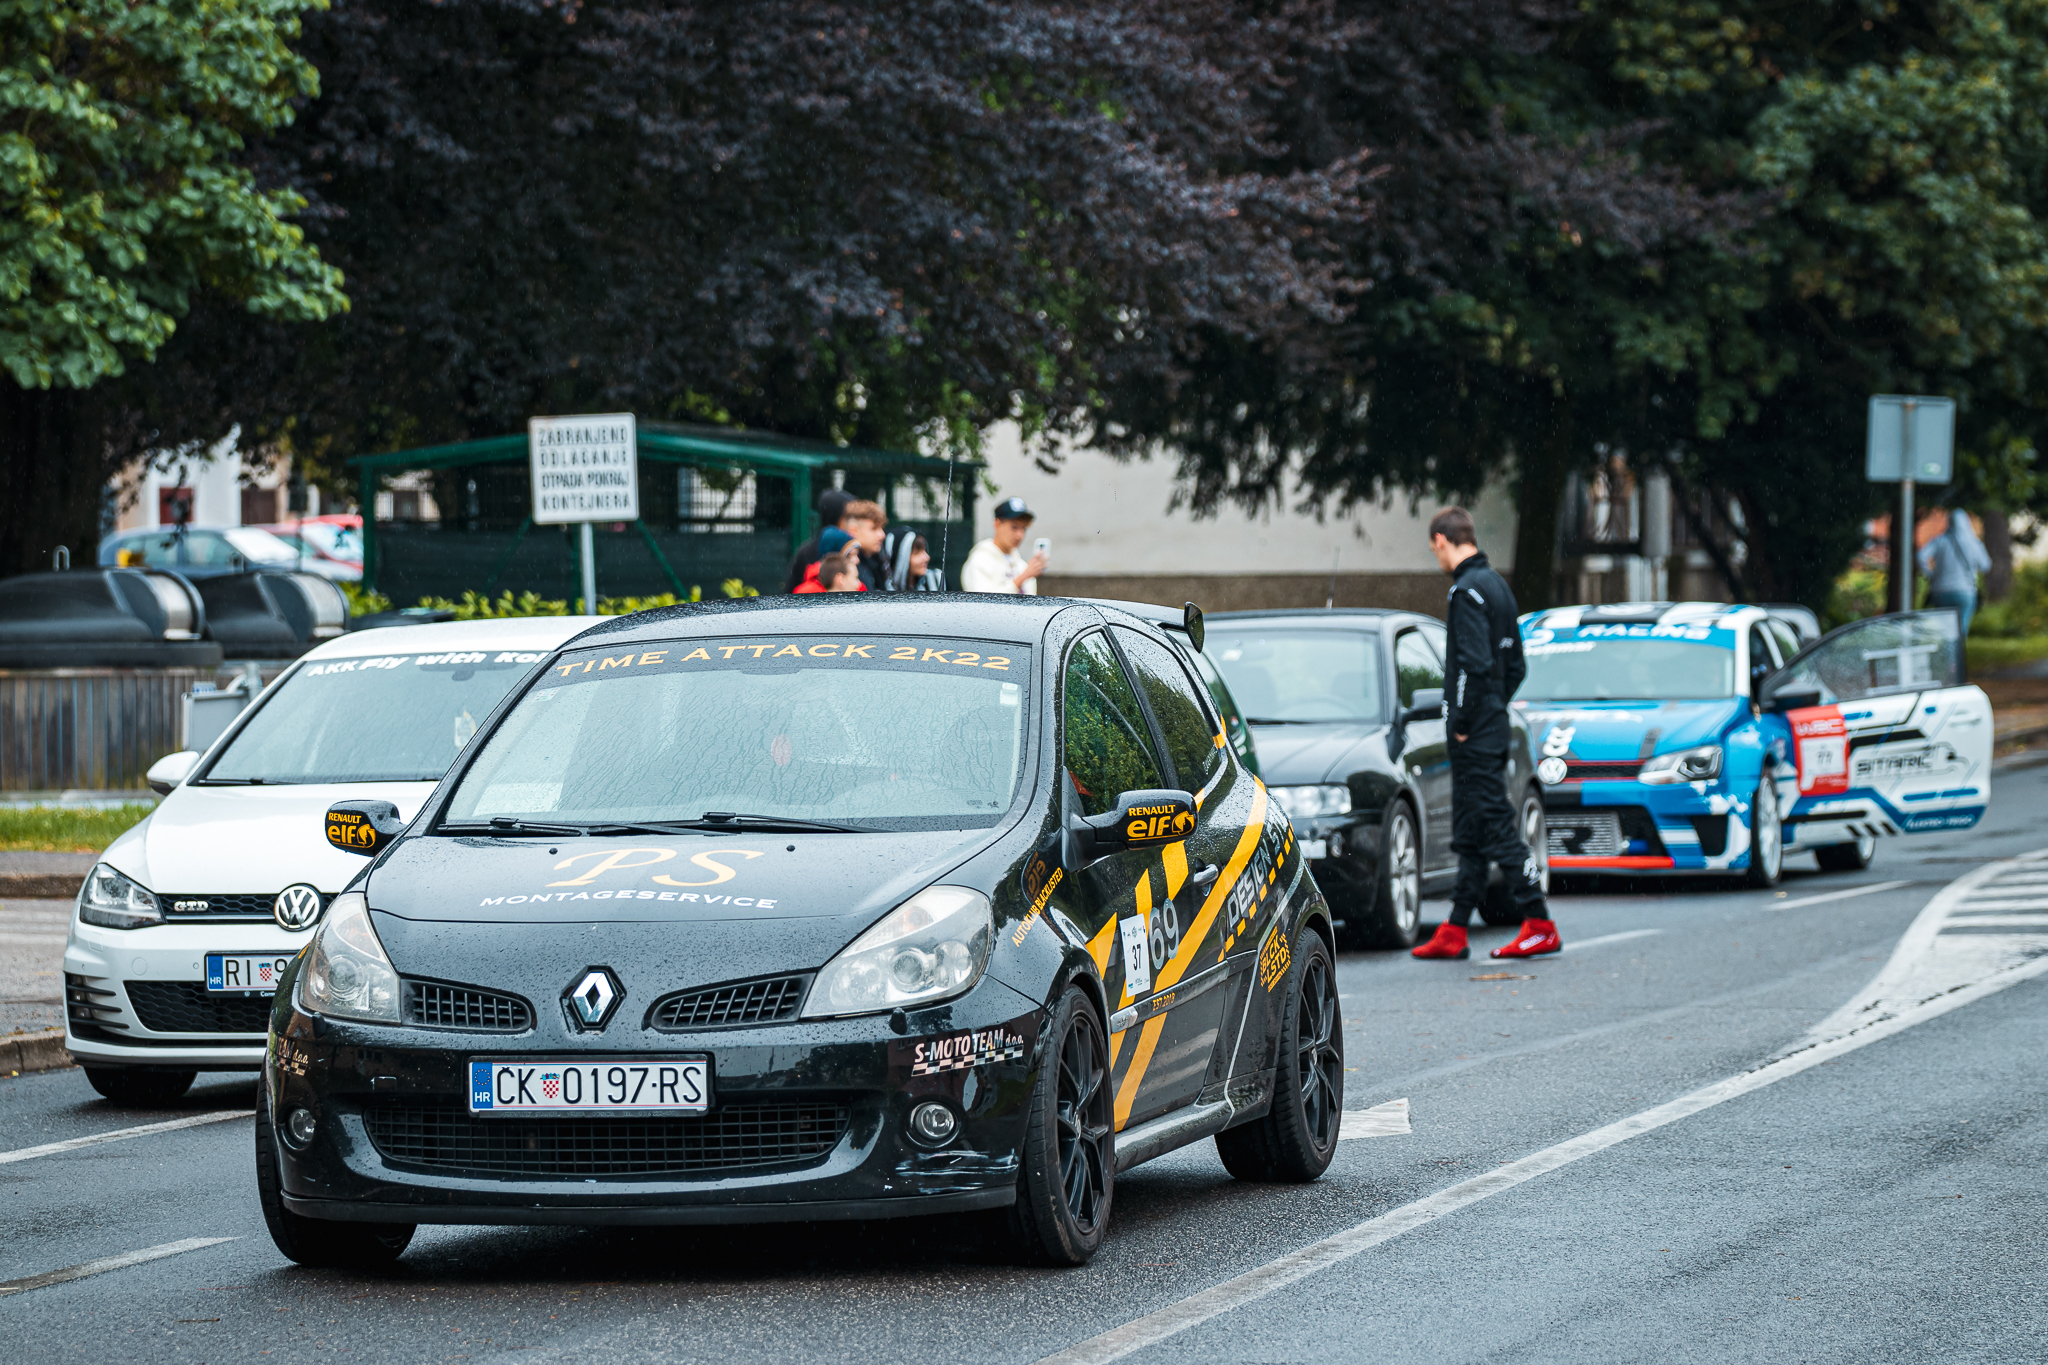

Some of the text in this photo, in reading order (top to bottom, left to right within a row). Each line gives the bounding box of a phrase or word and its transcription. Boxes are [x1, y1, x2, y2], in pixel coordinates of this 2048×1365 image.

[538, 425, 628, 447] ZABRANJENO
[540, 446, 628, 469] ODLAGANJE
[541, 470, 630, 490] OTPADA POKRAJ
[542, 491, 631, 511] KONTEJNERA
[306, 659, 360, 678] AKK
[556, 643, 1011, 677] TIME ATTACK 2K22
[328, 812, 362, 824] RENAULT
[1128, 804, 1176, 817] RENAULT
[327, 825, 357, 844] elf
[1126, 816, 1171, 838] elf
[1227, 838, 1272, 929] DESIGN
[480, 889, 778, 909] MONTAGESERVICE
[1011, 904, 1041, 948] AUTOKLUB
[1034, 866, 1064, 911] BLACKLISTED
[1149, 898, 1180, 970] 69
[1132, 943, 1142, 970] 37
[1262, 934, 1281, 974] BLCK
[1266, 946, 1287, 984] LSTD
[210, 977, 222, 985] HR
[225, 959, 251, 986] RI
[914, 1028, 1024, 1063] S-MOTO TEAM d.o.o.
[496, 1066, 538, 1104] ČK
[474, 1092, 491, 1102] HR
